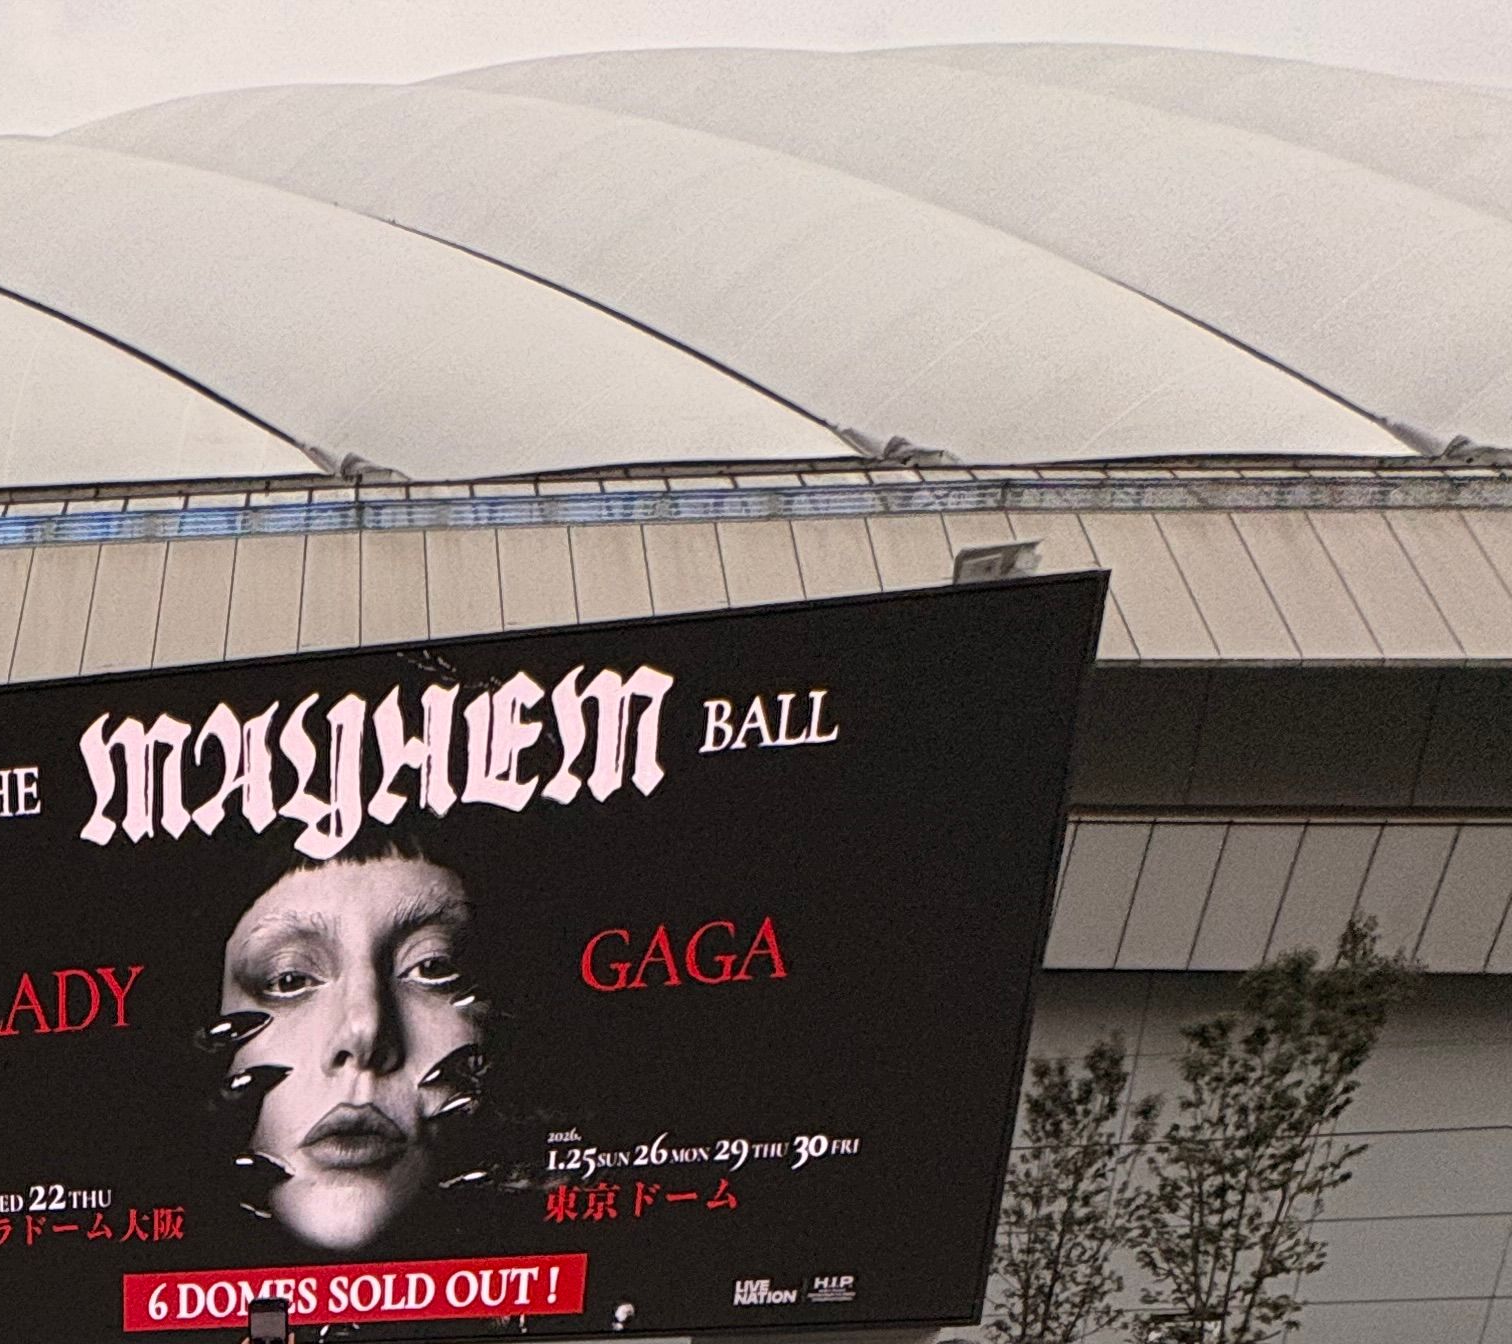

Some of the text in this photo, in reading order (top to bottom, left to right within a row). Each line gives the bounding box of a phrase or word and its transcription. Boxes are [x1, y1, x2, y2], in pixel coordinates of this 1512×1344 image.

[80, 665, 674, 860] MAYHEM
[698, 690, 839, 753] BALL
[580, 916, 787, 991] GAGA
[543, 1178, 738, 1222] 東京ドーム
[148, 1283, 169, 1320] 6
[176, 1277, 318, 1319] DOMES
[328, 1273, 435, 1314] SOLD
[446, 1267, 539, 1308] OUT
[733, 1290, 797, 1306] NATION
[735, 1279, 770, 1293] LIVE
